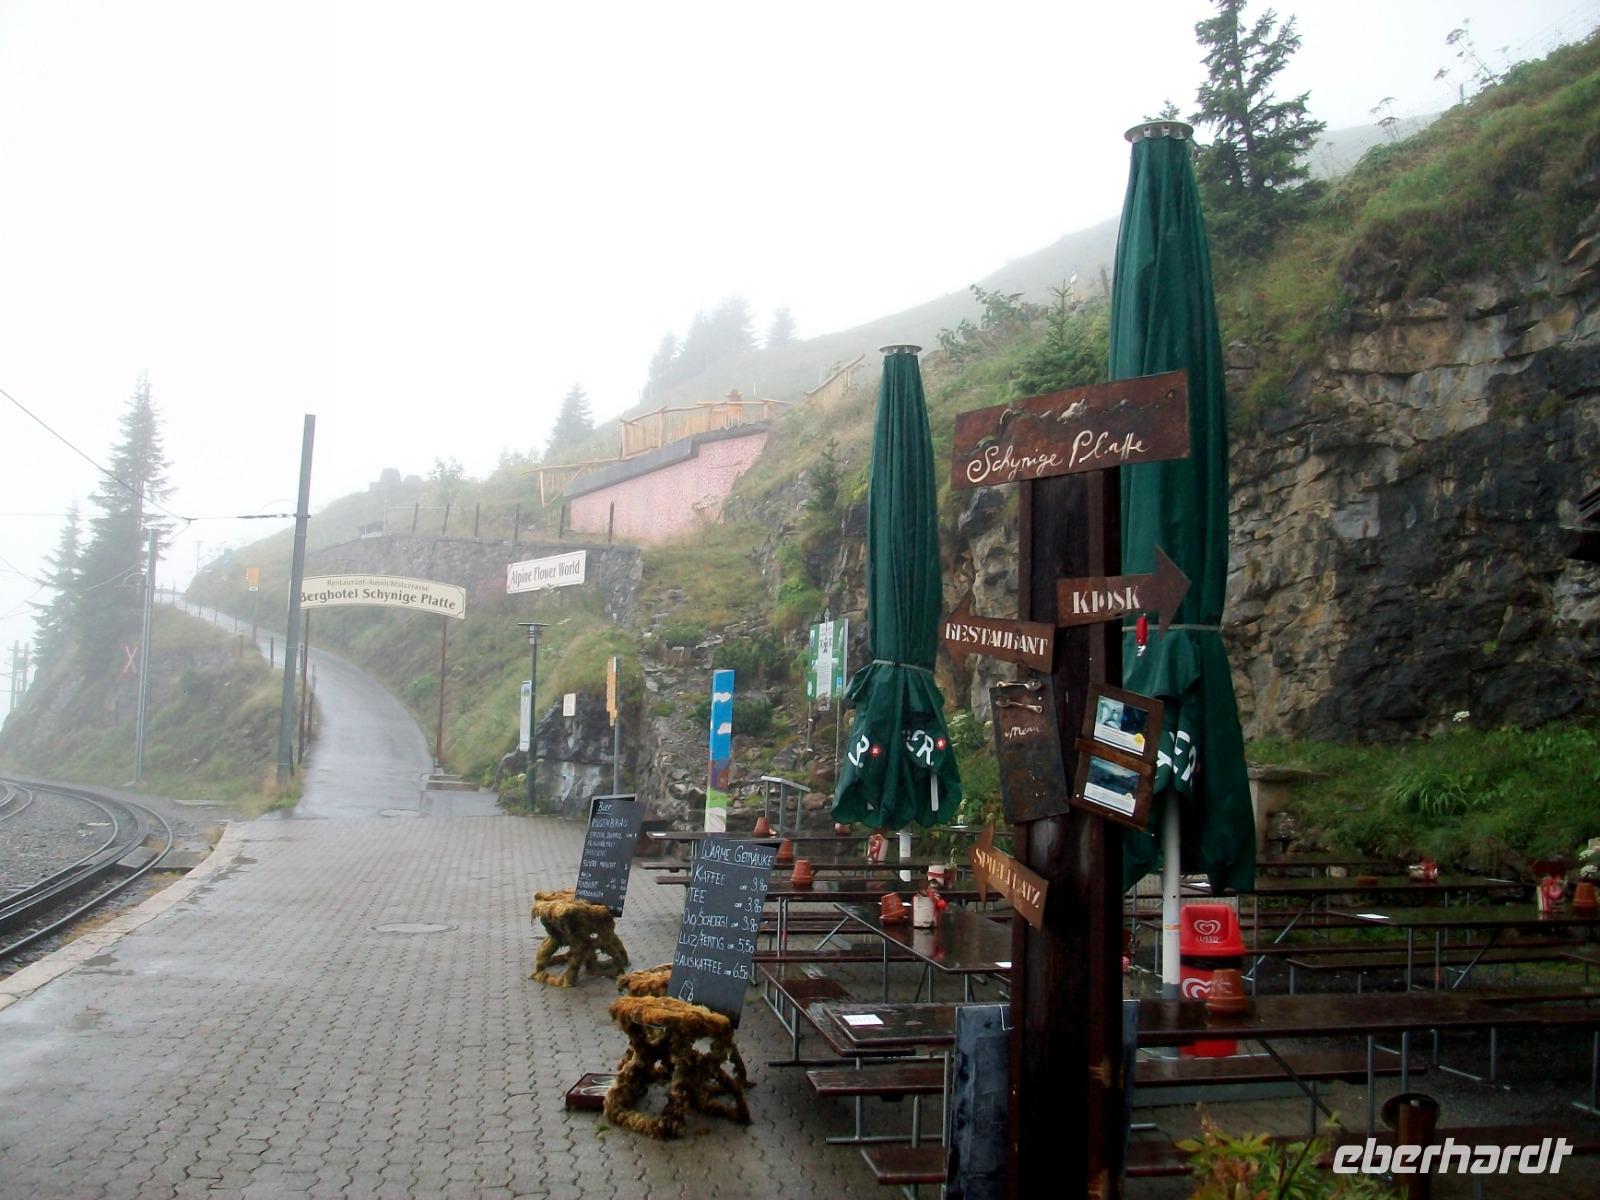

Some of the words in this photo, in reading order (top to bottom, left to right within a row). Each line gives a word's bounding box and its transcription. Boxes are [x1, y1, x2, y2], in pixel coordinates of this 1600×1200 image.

[967, 445, 1062, 483] Schynige
[1069, 430, 1149, 469] Platte
[512, 570, 532, 587] Alpine
[533, 566, 557, 581] Flower
[558, 559, 580, 577] World
[301, 588, 359, 604] Berghotel
[362, 588, 417, 603] Schynige
[420, 593, 456, 610] Platte
[1073, 585, 1141, 614] KIOSK
[945, 622, 1049, 656] RESTAURANT
[694, 864, 726, 886] KAFFEE
[689, 886, 708, 904] TEE
